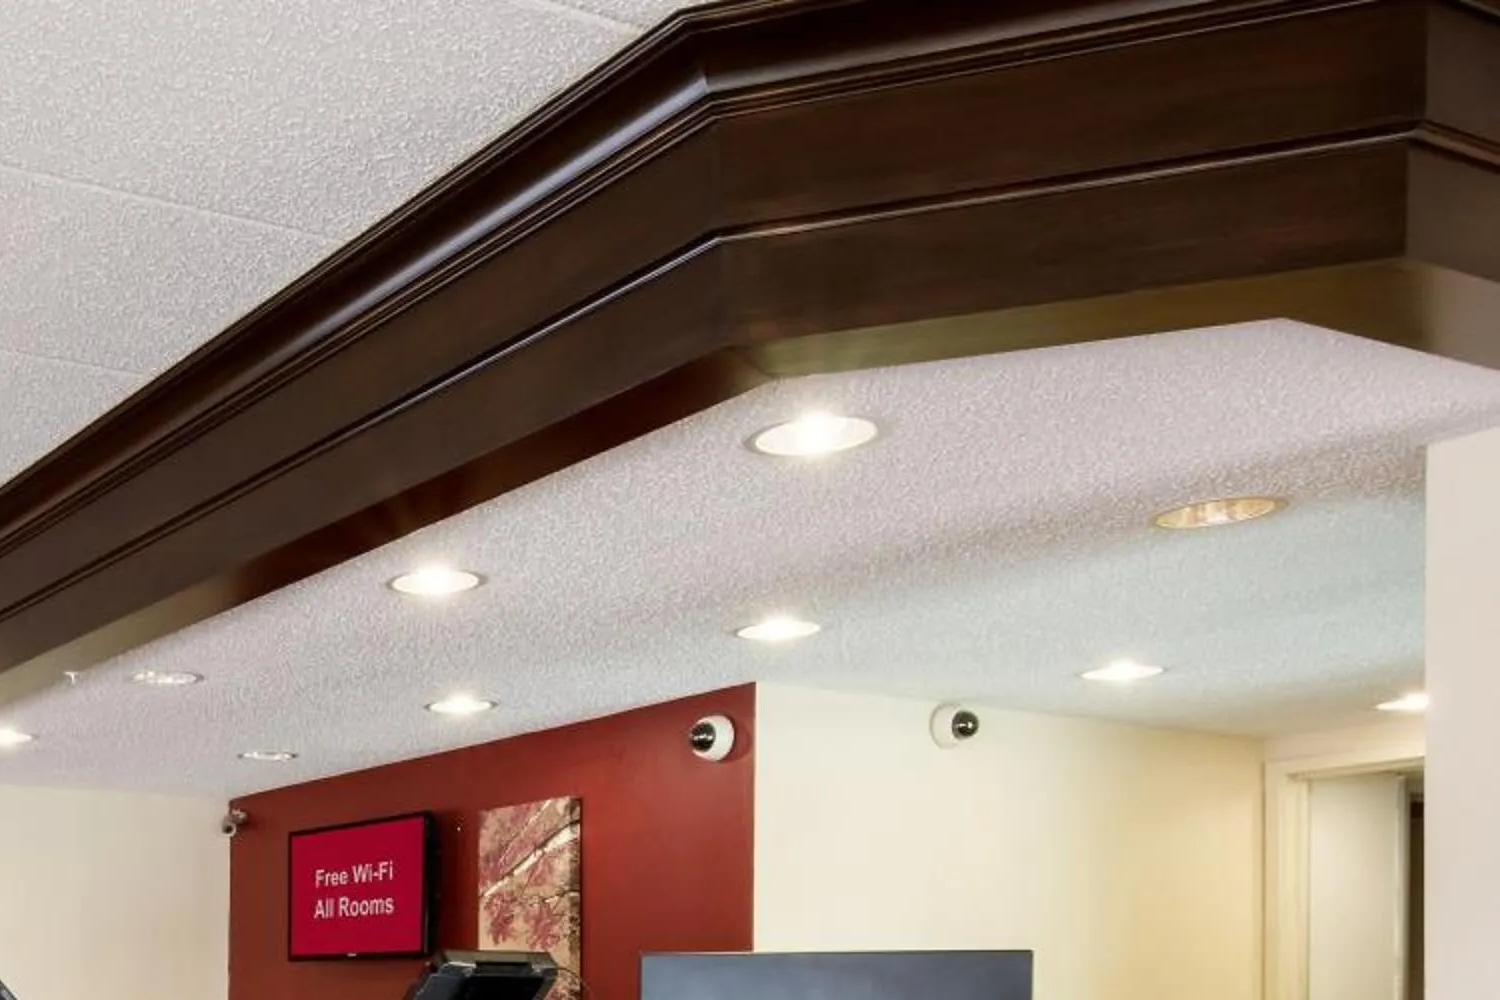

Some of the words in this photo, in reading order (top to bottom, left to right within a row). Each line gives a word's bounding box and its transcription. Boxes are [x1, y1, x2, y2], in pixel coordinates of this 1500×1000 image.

[315, 869, 348, 888] Free
[352, 860, 393, 883] Wi-Fi
[314, 899, 335, 919] All
[339, 896, 395, 917] Rooms
